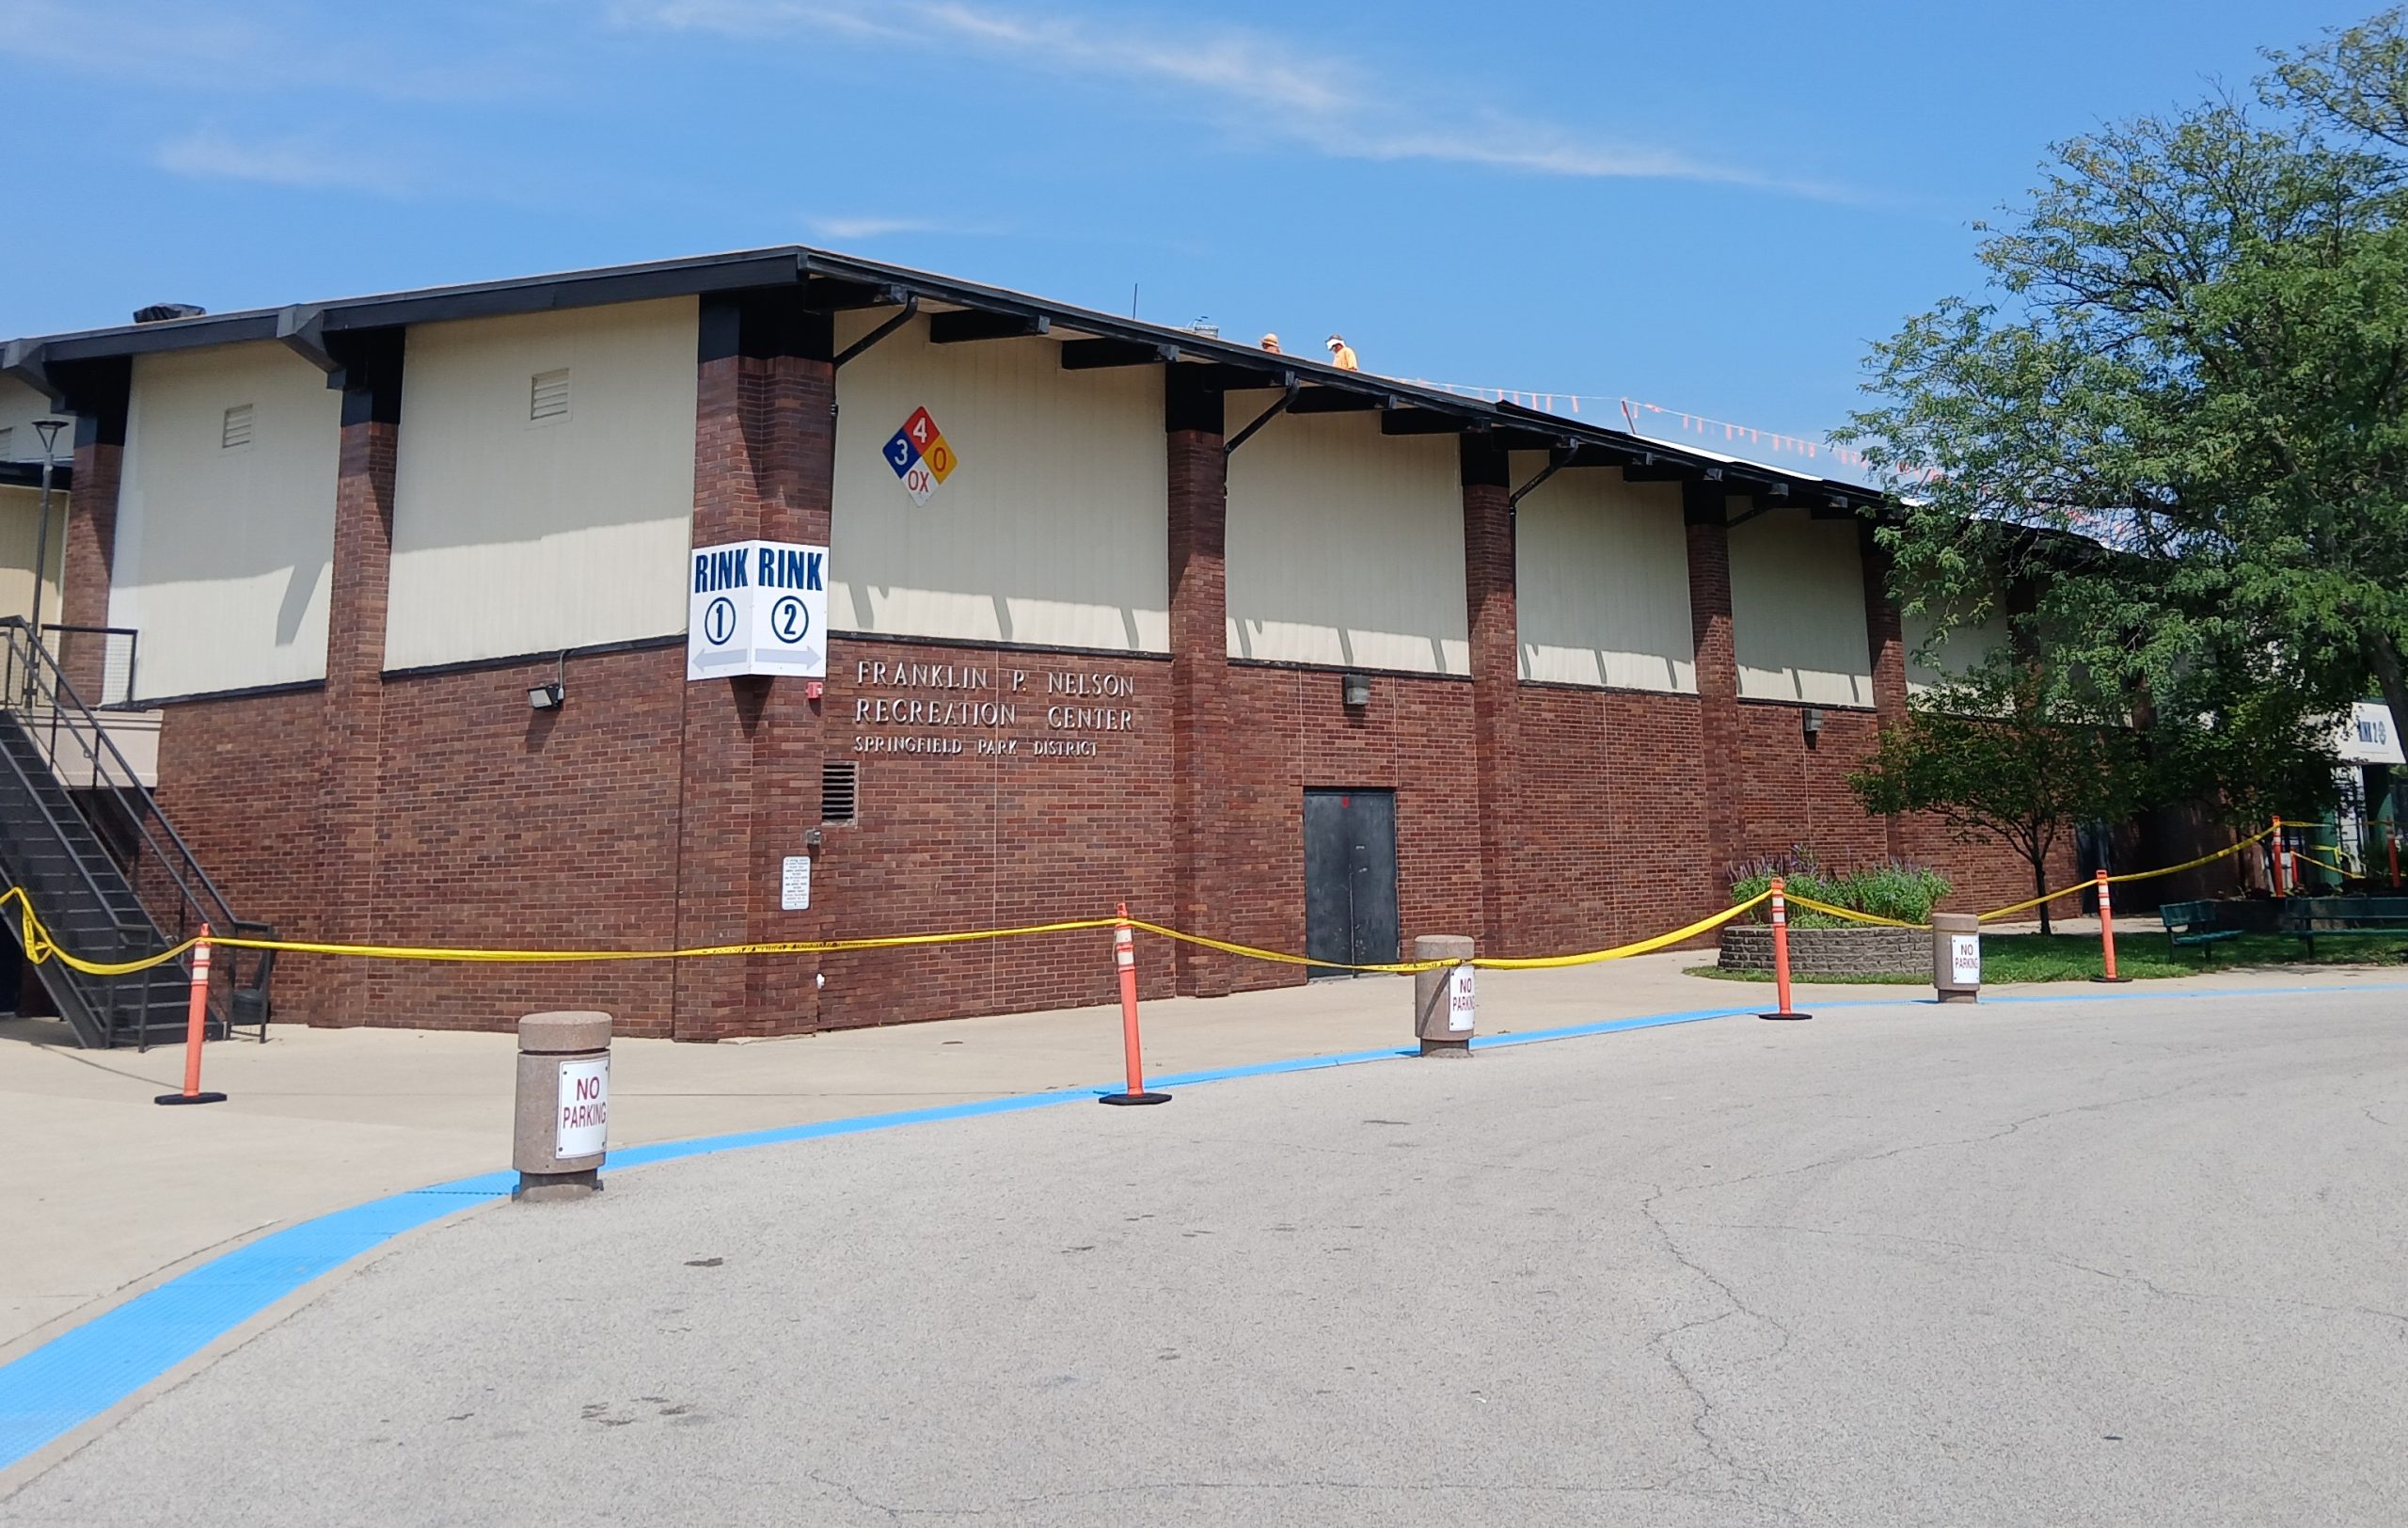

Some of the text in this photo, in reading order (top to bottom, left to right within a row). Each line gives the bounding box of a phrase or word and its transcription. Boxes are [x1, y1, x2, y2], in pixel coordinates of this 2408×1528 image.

[913, 417, 927, 443] 4
[895, 438, 908, 466] 3
[933, 447, 947, 472] 0
[908, 470, 929, 492] OX
[694, 547, 750, 594] RINK
[758, 547, 823, 592] RINK
[716, 603, 723, 638] 1
[784, 603, 797, 635] 2
[857, 661, 1134, 697] FRANKLIN P. NELSON
[855, 698, 1133, 731] RECREATION CENTER
[853, 736, 1099, 758] SPRINGFIELD PARK DISTRICT
[1960, 944, 1973, 956] NO
[1460, 978, 1472, 994] NO
[576, 1075, 600, 1101] NO
[562, 1102, 607, 1129] PARKING
